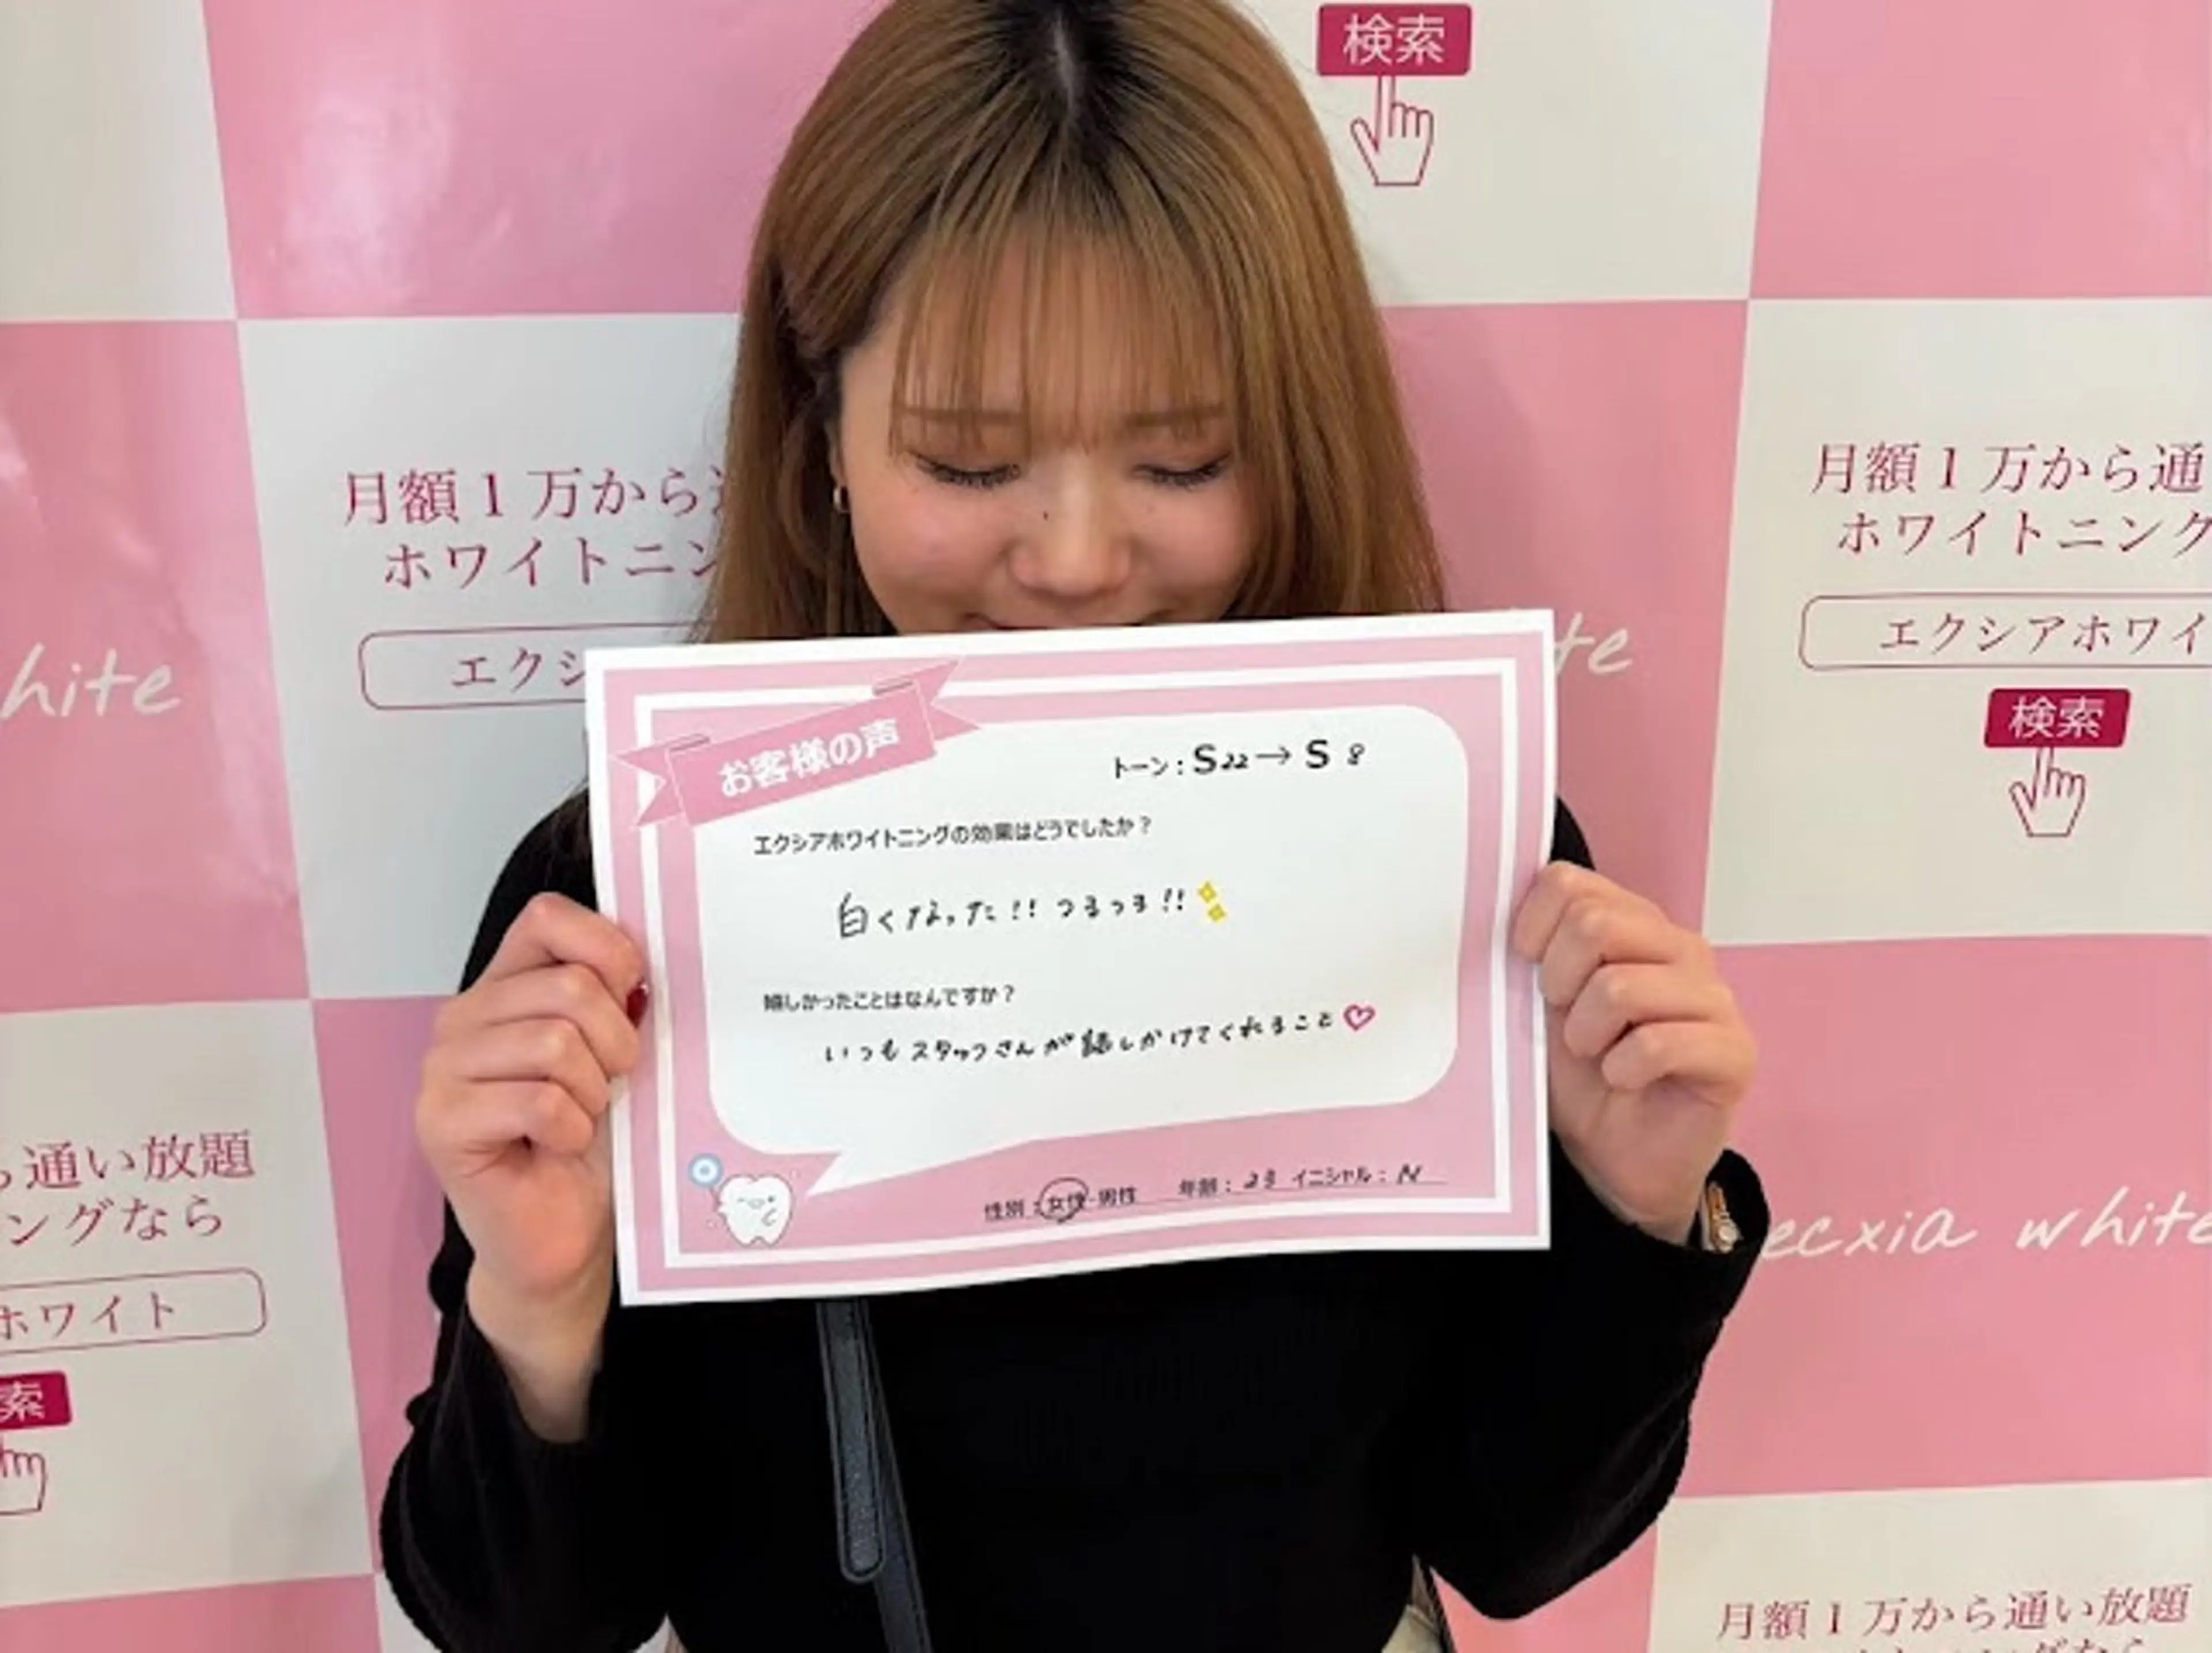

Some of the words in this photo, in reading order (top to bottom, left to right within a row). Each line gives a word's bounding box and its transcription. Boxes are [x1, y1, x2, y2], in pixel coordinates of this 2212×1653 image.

[1343, 13, 1445, 66] 検索
[1812, 441, 2205, 495] 月額1万から通
[344, 465, 724, 526] 月額1万から
[1880, 612, 2206, 655] エクシアホワイ
[452, 647, 585, 692] エクシ
[2008, 695, 2106, 740] 検索
[718, 718, 900, 798] お客様の声
[753, 816, 1153, 856] エクシアホワイトニングの効果はどうでしたか？
[763, 984, 1016, 1013] 嬉しかったことはなんですか？
[0, 1129, 256, 1192] 通い放題
[8, 1194, 222, 1248] ングなら
[1760, 1207, 1978, 1260] ecxia
[1717, 1583, 2192, 1641] 月額1万から通い放題
